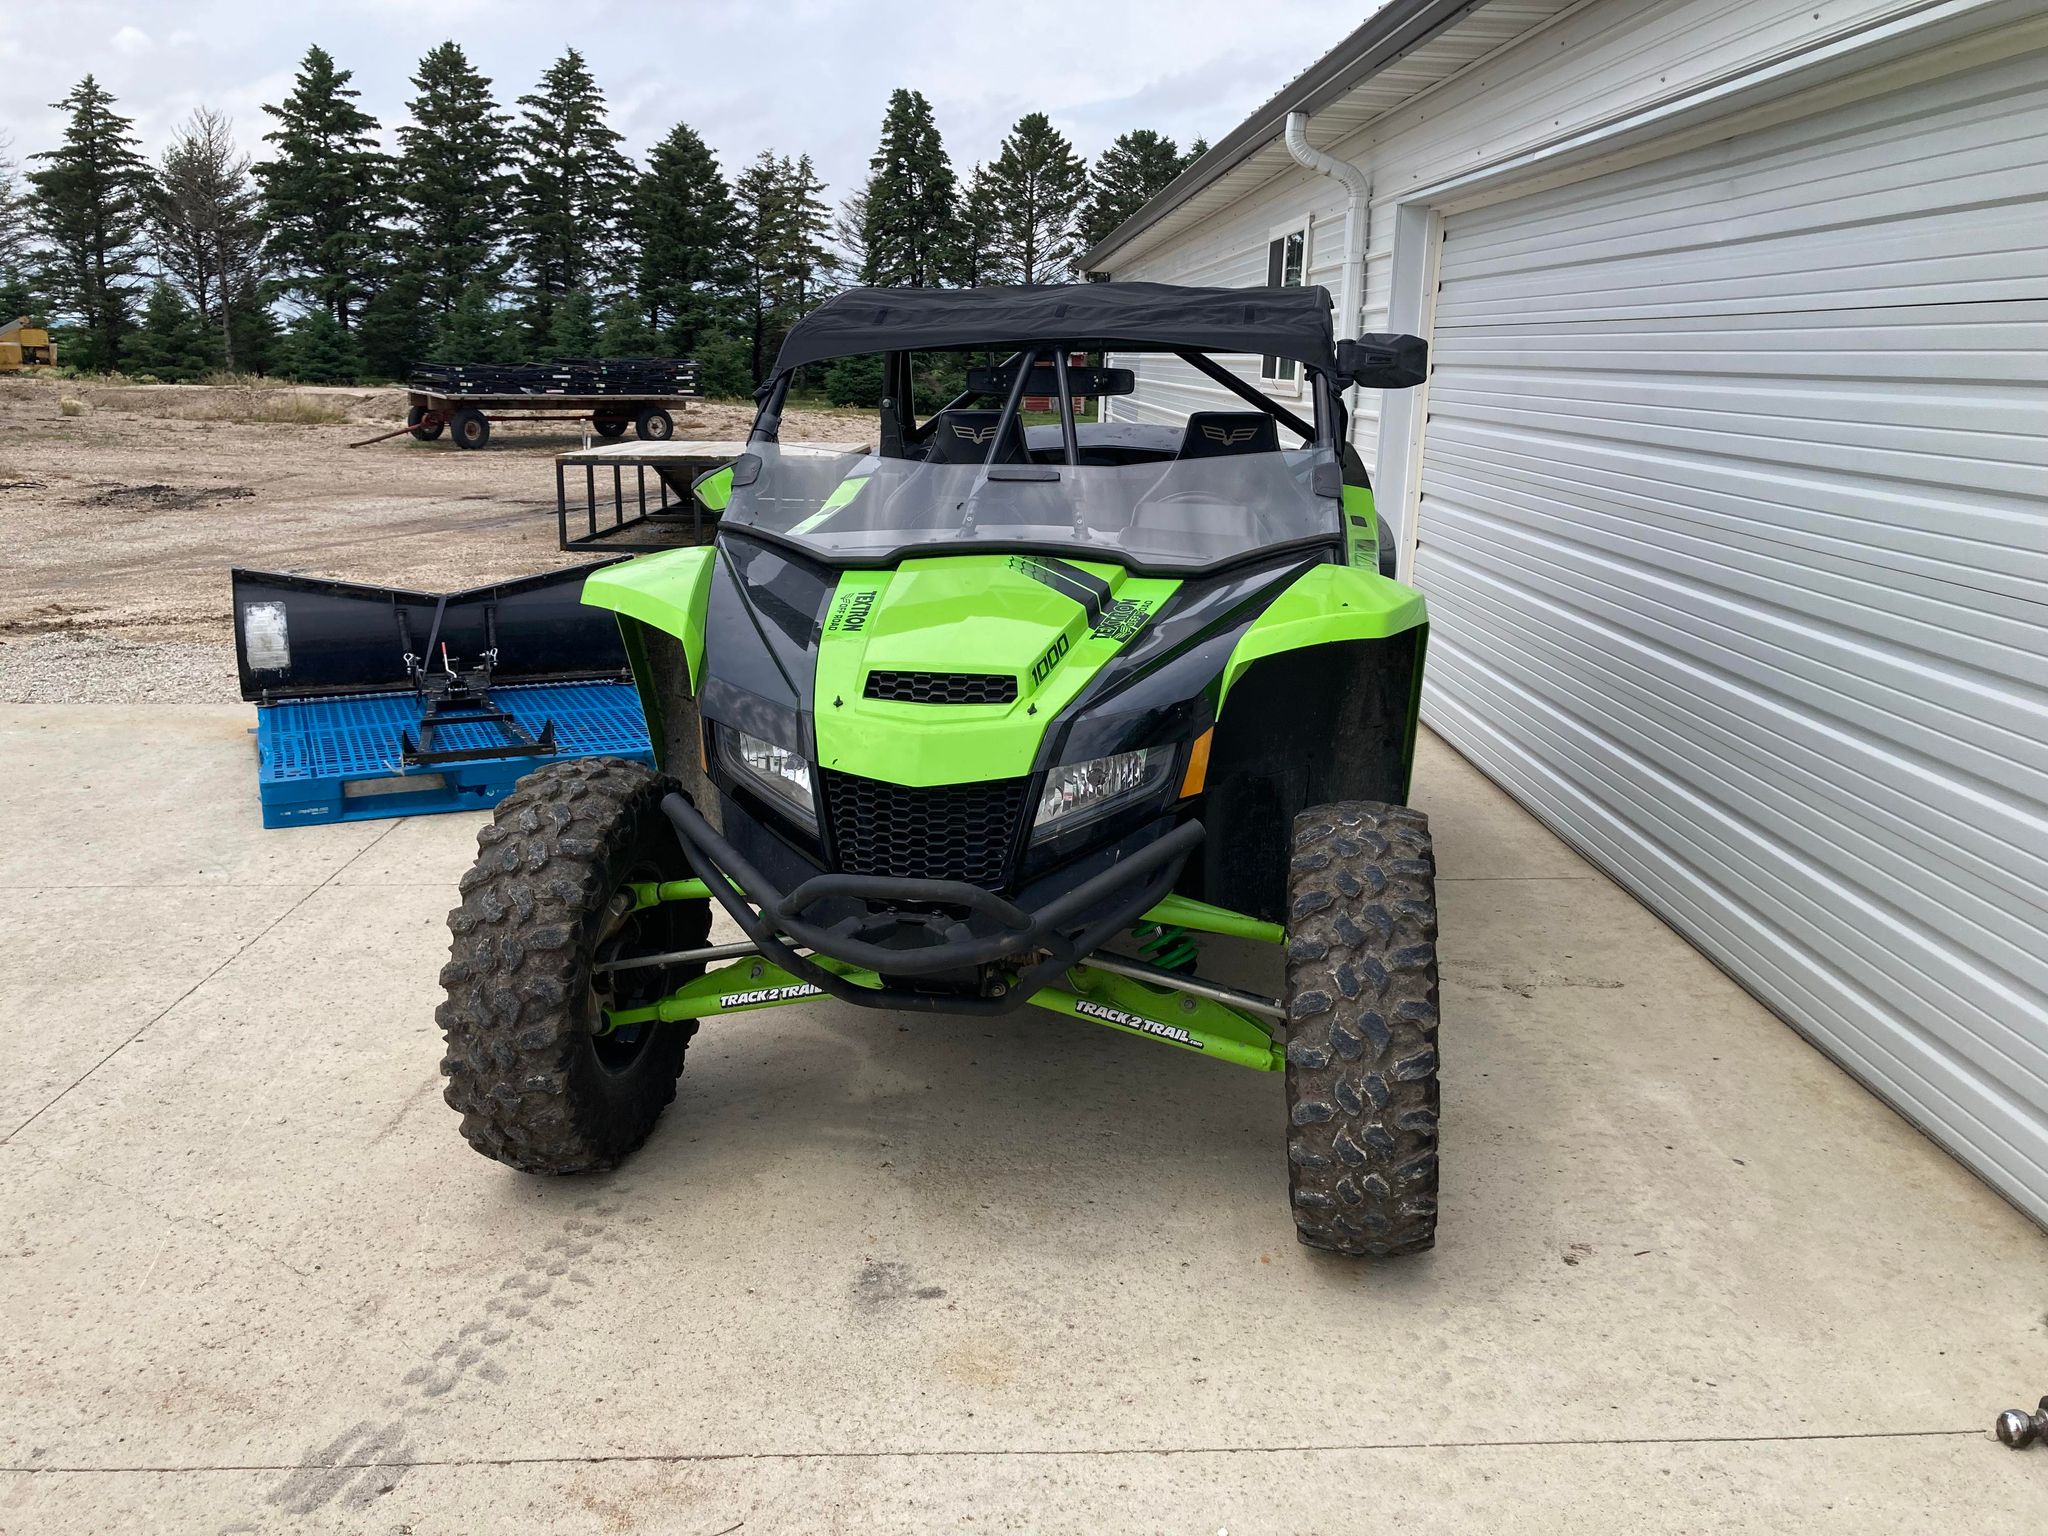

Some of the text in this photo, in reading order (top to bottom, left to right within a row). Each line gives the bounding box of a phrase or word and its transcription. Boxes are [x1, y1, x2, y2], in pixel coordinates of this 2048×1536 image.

[828, 603, 848, 631] OFF ROAD
[841, 591, 878, 632] TEXTRON
[1031, 633, 1069, 687] 1000
